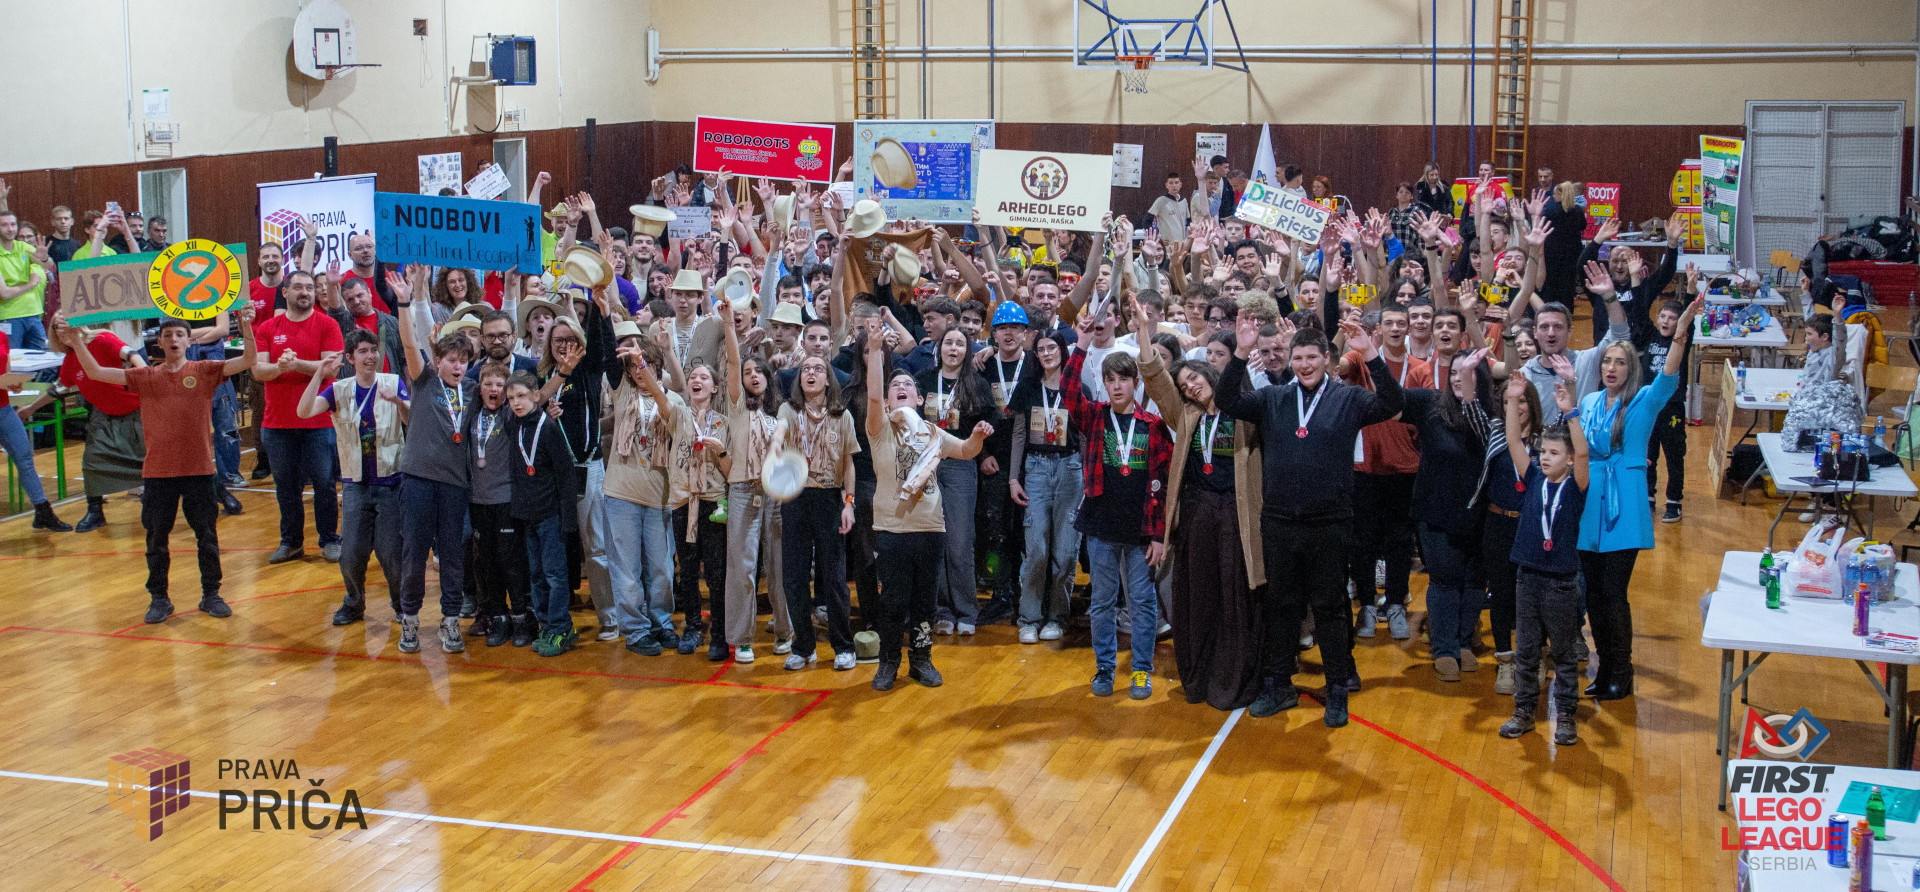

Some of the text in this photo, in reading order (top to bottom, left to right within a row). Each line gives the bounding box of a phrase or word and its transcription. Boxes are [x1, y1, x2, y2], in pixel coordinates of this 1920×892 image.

[704, 131, 790, 149] ROBOROOTS
[1588, 186, 1619, 202] ROOTY
[998, 201, 1087, 217] ARHEOLEGO
[312, 210, 347, 228] PRAVA
[395, 204, 500, 234] NOOBOVI
[1050, 216, 1075, 225] RAŠKA
[69, 268, 149, 314] AION
